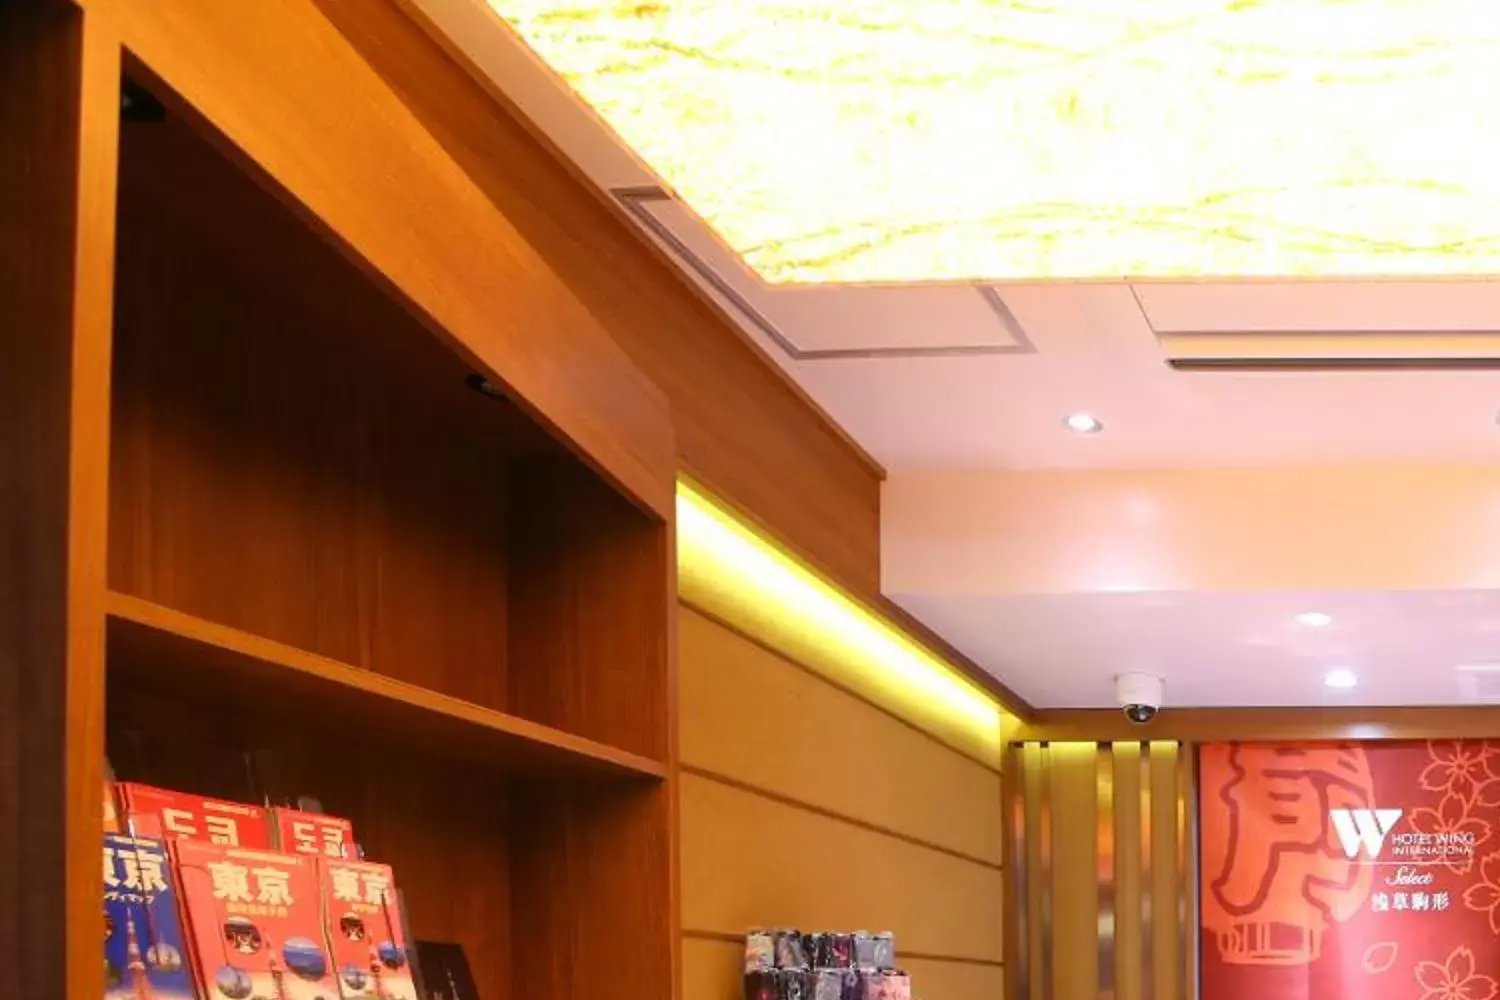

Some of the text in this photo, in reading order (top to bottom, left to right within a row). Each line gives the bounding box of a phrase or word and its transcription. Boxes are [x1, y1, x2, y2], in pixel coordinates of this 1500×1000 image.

[1330, 809, 1403, 858] W
[1392, 832, 1475, 845] HOTEL WING
[1392, 846, 1474, 856] INTERNATIONAL
[208, 861, 294, 906] 東京
[329, 868, 391, 906] 東京
[1384, 866, 1434, 886] Select
